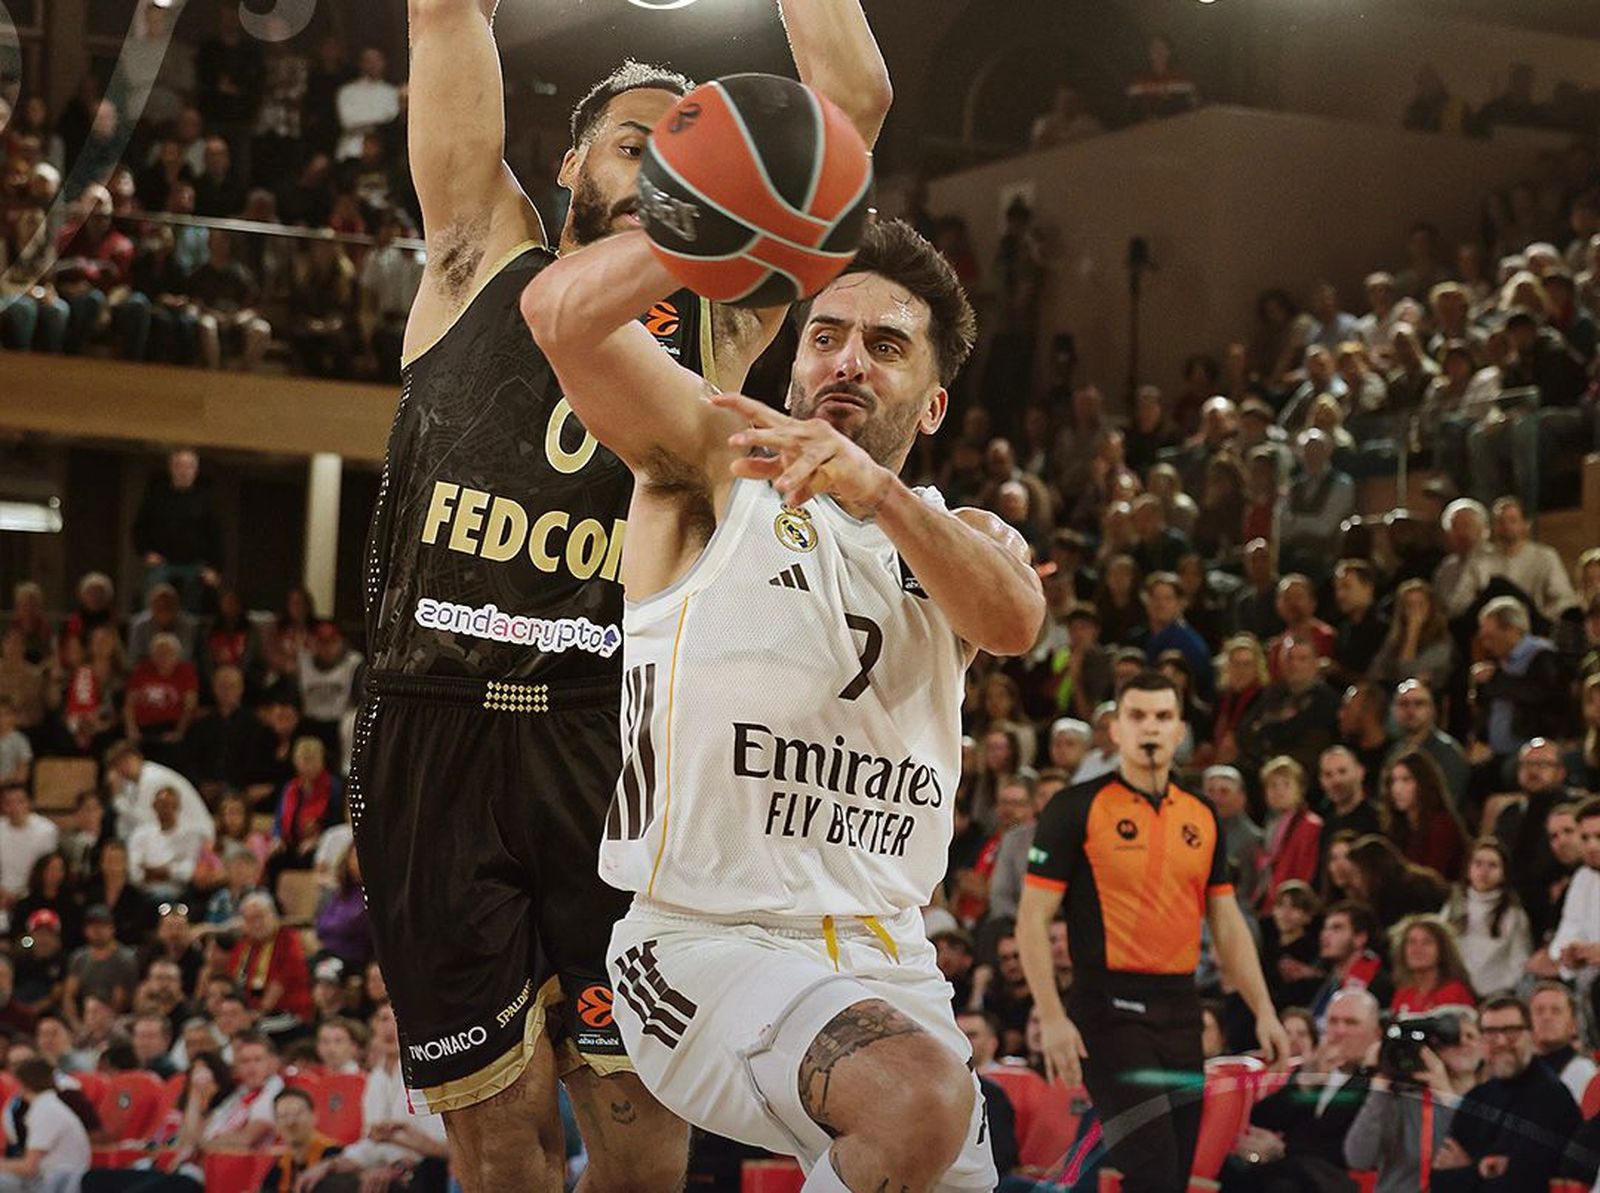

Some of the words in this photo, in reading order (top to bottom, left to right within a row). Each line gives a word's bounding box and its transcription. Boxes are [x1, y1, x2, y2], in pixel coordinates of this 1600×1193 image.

[418, 601, 602, 649] zondacrypto
[732, 722, 943, 808] Emirates
[764, 792, 821, 838] FLY
[826, 802, 916, 857] BETTER
